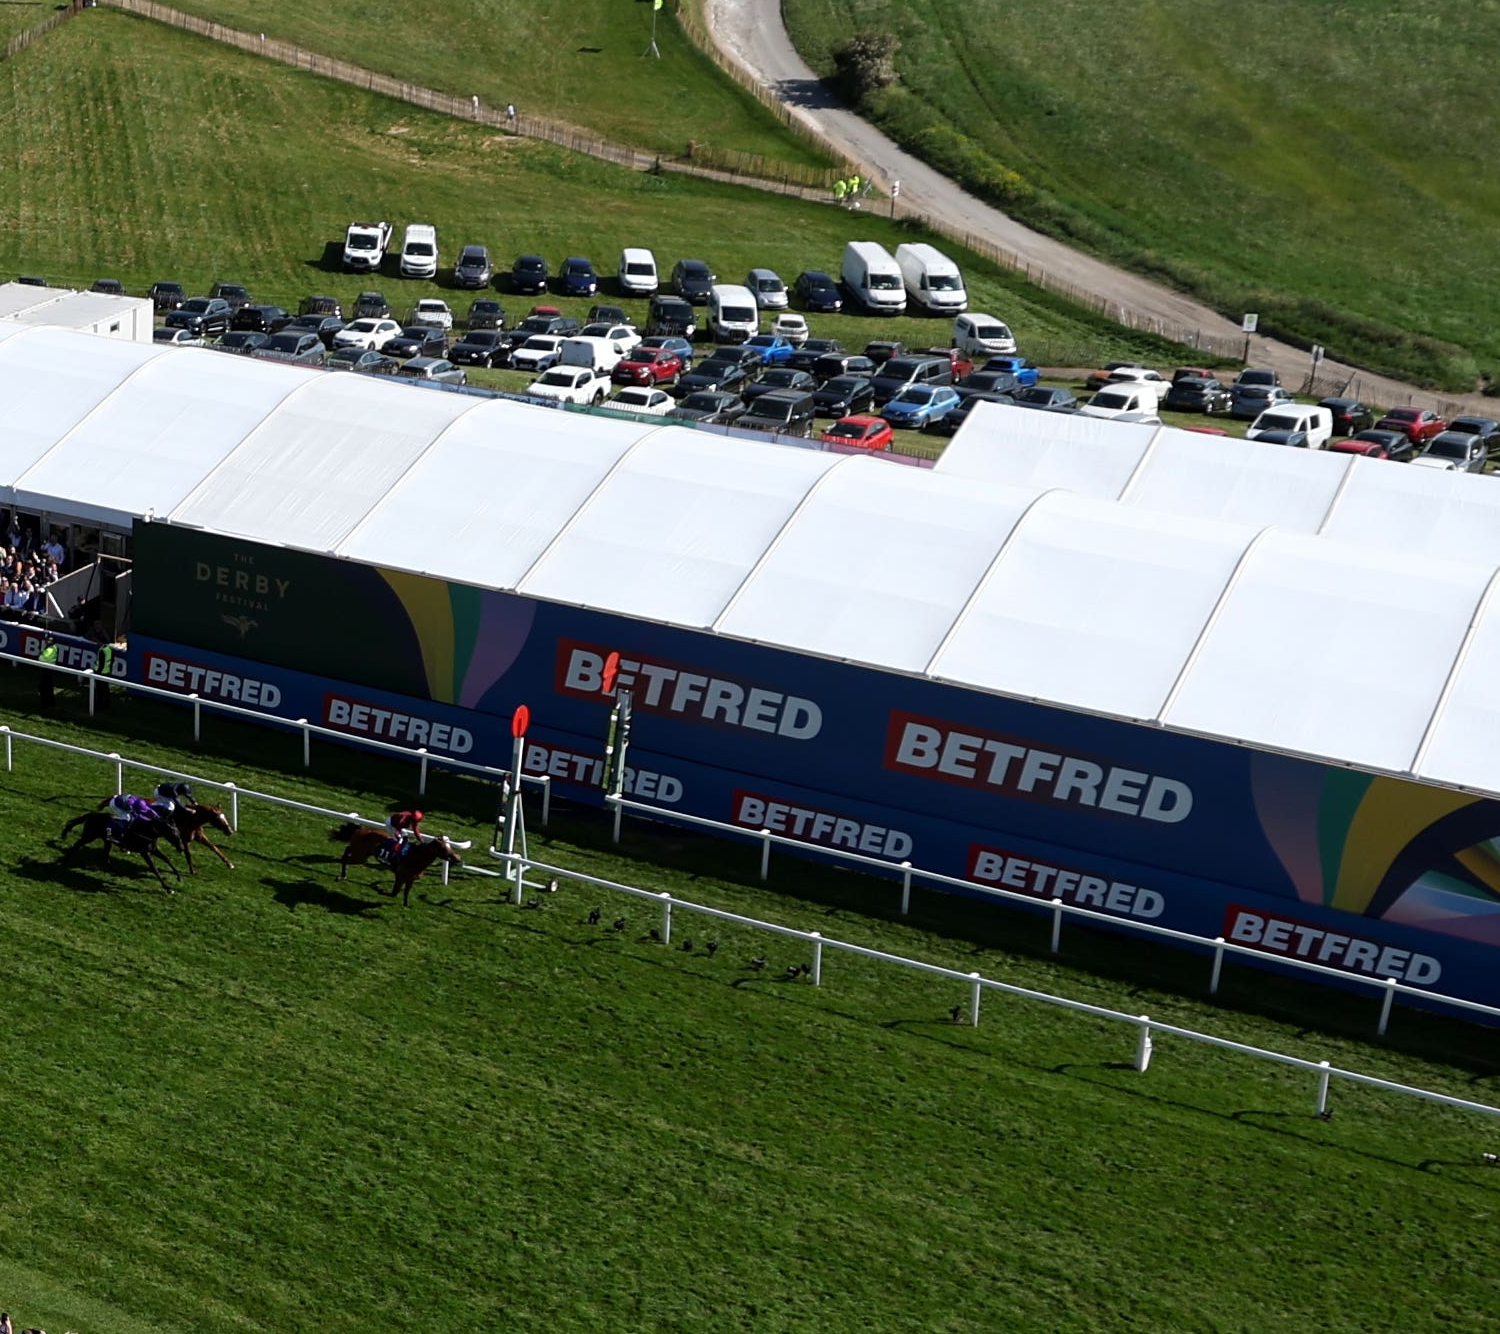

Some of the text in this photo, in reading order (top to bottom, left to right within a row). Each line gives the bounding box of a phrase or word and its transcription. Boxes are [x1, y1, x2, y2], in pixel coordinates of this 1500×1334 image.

[196, 562, 291, 598] DERBY
[234, 553, 255, 564] THE
[216, 592, 269, 612] FESTIVAL
[148, 657, 281, 708] BETFRED
[328, 699, 474, 754] BETFRED
[896, 722, 1194, 823] BETFRED
[738, 796, 913, 859] BETFRED
[973, 851, 1165, 918] BETFRED
[1230, 912, 1442, 985] BETFRED
